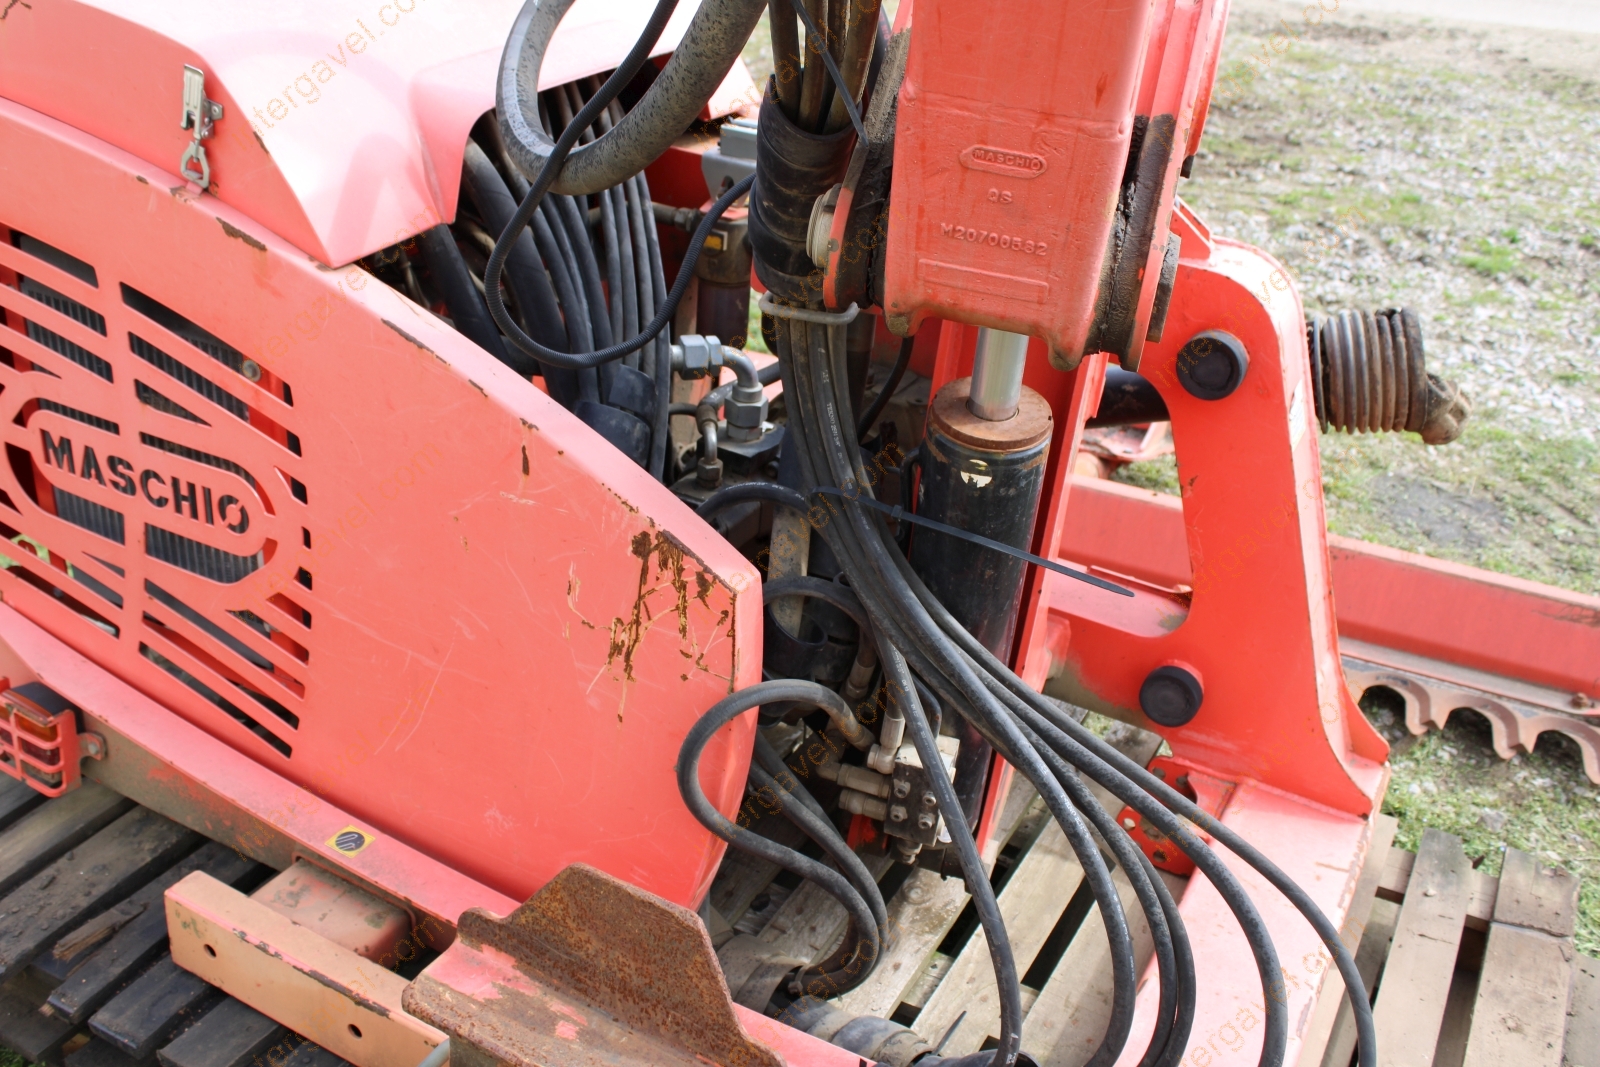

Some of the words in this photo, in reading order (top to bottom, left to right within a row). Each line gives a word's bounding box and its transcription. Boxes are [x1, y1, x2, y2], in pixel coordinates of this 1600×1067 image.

[972, 149, 1042, 171] MASCHIO
[987, 187, 1014, 205] QS
[940, 222, 1049, 257] M20700582
[39, 427, 250, 535] MASCHIO
